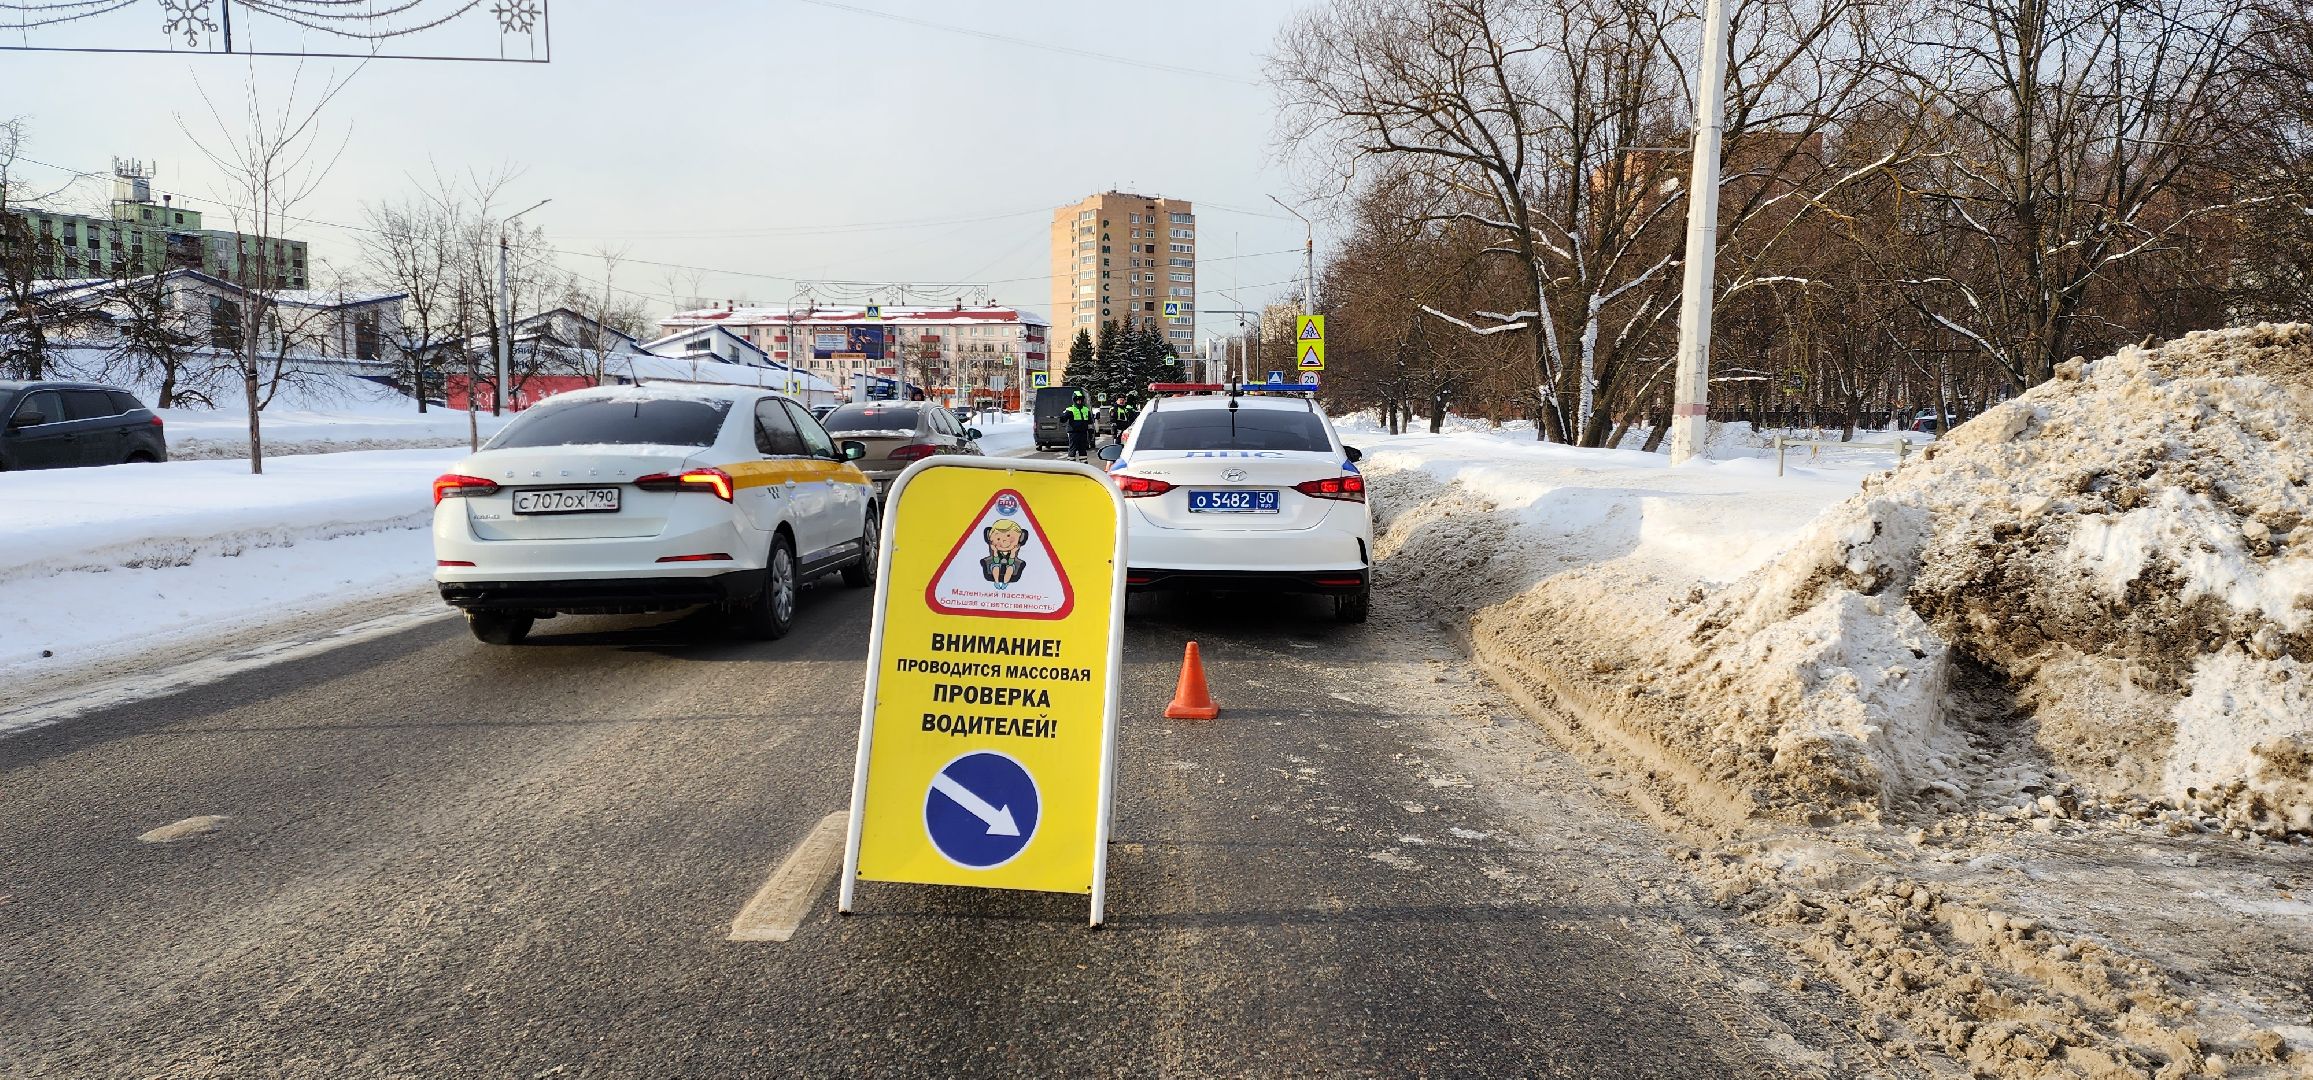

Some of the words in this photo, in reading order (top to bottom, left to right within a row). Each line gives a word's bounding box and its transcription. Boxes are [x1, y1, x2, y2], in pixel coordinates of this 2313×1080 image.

[1304, 375, 1315, 384] 20
[1182, 451, 1285, 459] ДПС
[588, 490, 613, 503] 790
[1212, 492, 1250, 508] 5482
[1259, 492, 1274, 504] 50
[951, 588, 999, 599] Маленький
[1001, 592, 1042, 601] пассажир
[931, 632, 1062, 658] ВНИМАНИЕ!
[897, 658, 1001, 678] ПРОВОДИТСЯ
[1005, 665, 1091, 682] МАССОВАЯ
[933, 683, 1051, 708] ПРОВЕРКА
[921, 713, 1058, 739] ВОДИТЕЛЕЙ!
